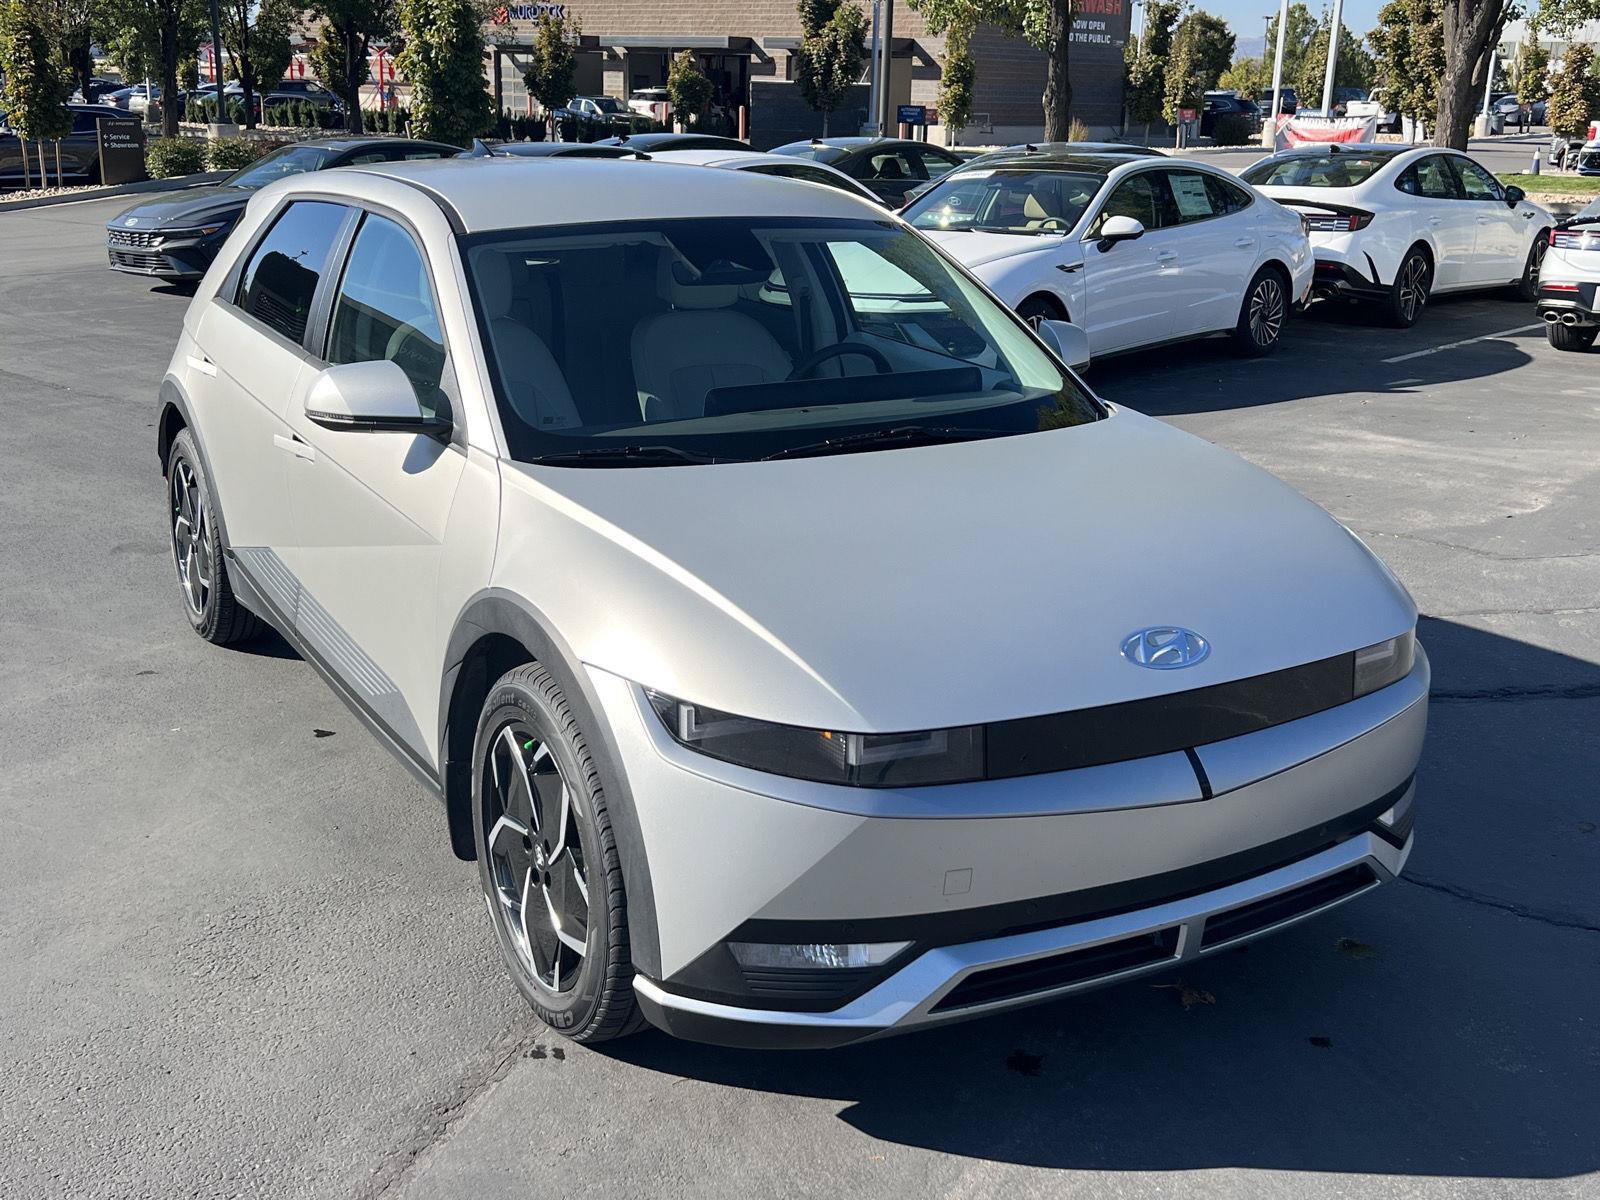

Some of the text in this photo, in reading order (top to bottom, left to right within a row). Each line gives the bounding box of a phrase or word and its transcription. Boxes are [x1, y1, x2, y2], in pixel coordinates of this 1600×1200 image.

[1088, 21, 1105, 30] OPEN
[1075, 33, 1087, 42] THE
[1089, 34, 1111, 43] PUBLIC
